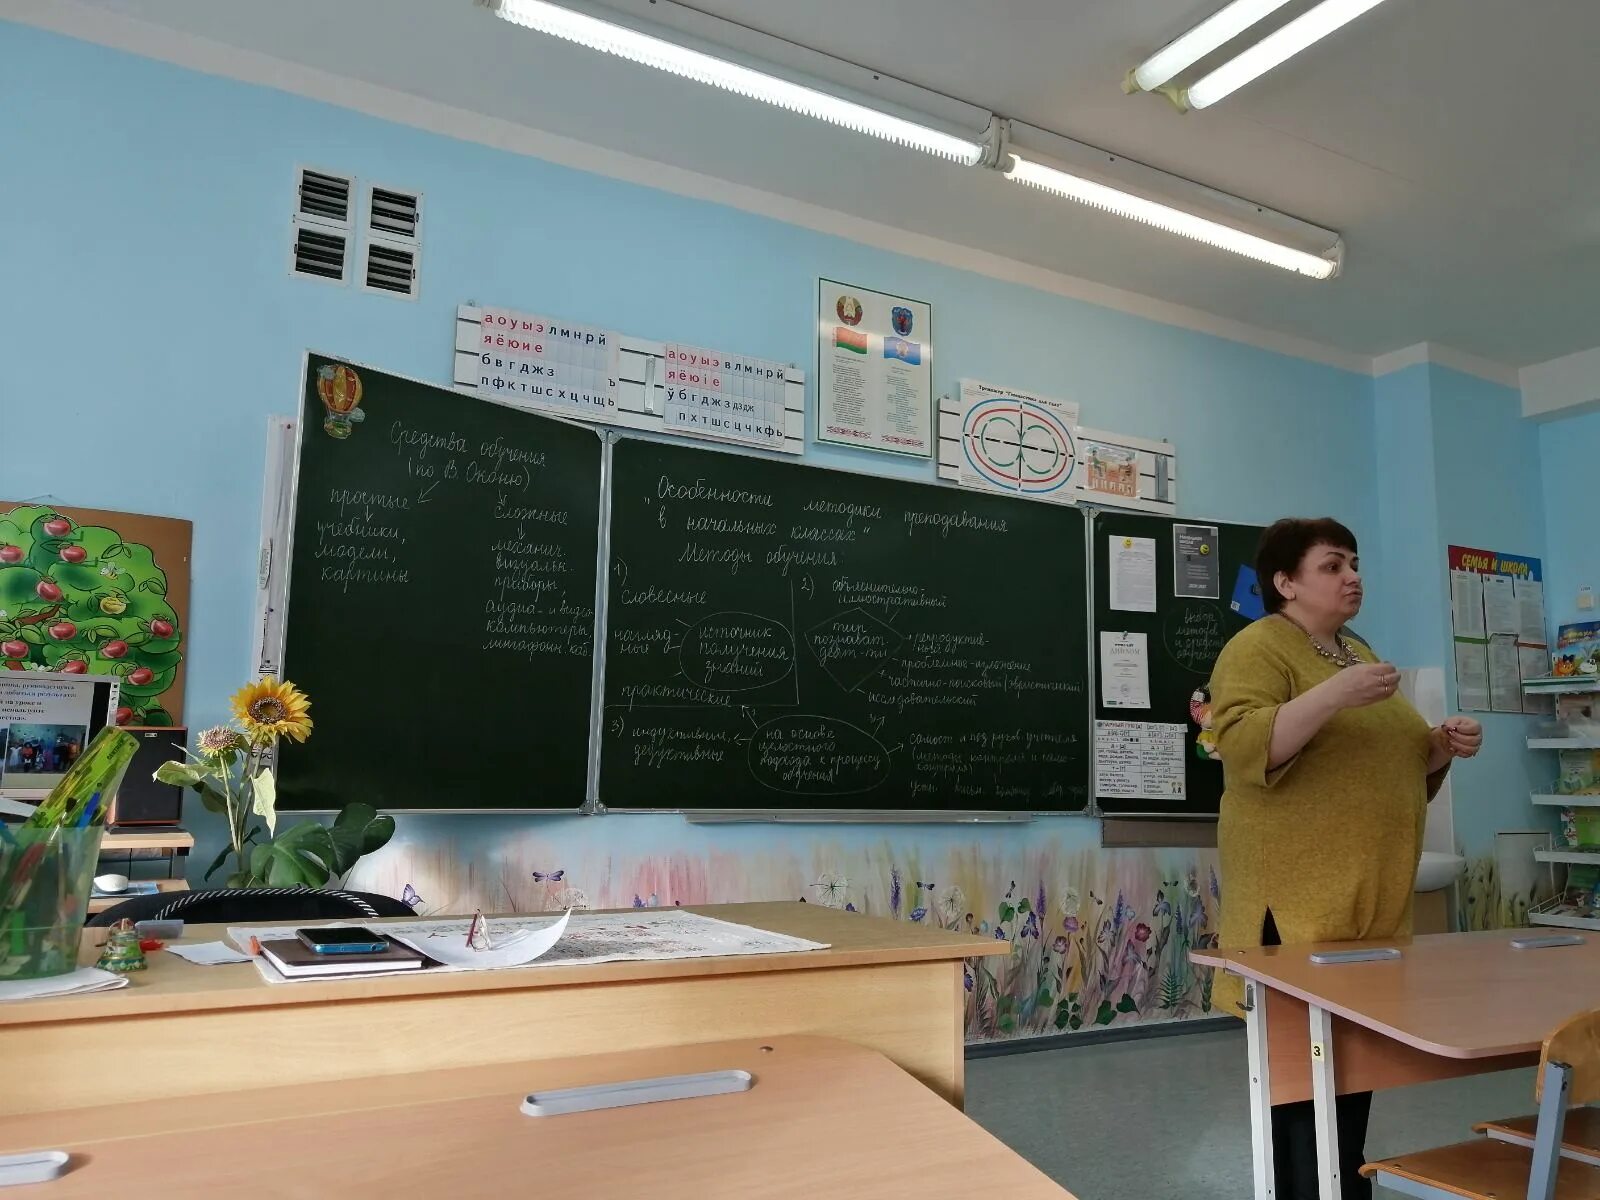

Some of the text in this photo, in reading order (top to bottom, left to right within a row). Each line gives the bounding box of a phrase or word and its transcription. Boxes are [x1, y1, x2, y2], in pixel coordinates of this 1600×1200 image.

[484, 314, 605, 345] а о у ы э л м н р й
[484, 334, 542, 353] я ё ю и е
[482, 353, 491, 365] б
[495, 359, 502, 367] в
[509, 361, 515, 370] г
[520, 363, 529, 374] д
[532, 365, 544, 375] ж
[668, 350, 676, 359] а
[679, 353, 687, 361] о
[690, 354, 697, 365] у
[701, 357, 710, 365] ы
[712, 359, 720, 367] э
[734, 363, 741, 371] л
[744, 365, 752, 373] м
[756, 367, 763, 376] н
[766, 369, 773, 379] р
[777, 369, 783, 380] й
[608, 378, 616, 387] ъ
[668, 369, 720, 387] я ё ю і е
[481, 376, 614, 408] п ф к т ш с х ц ч щ ь
[667, 388, 674, 401] ў
[679, 388, 687, 400] б
[691, 394, 698, 402] г
[701, 396, 709, 406] д
[711, 397, 721, 407] ж
[724, 400, 730, 408] з
[679, 413, 783, 438] п х т ш с ц ч к ф ь
[390, 420, 467, 458] Средства
[329, 488, 410, 518] простые
[686, 515, 777, 538] начальных
[803, 499, 882, 527] методики
[905, 509, 1008, 539] преподавания
[679, 542, 753, 576] Методы
[1461, 553, 1528, 577] СЕМЬЯ И ШКОЛА
[321, 566, 409, 594] картины
[1313, 1045, 1321, 1057] 3
